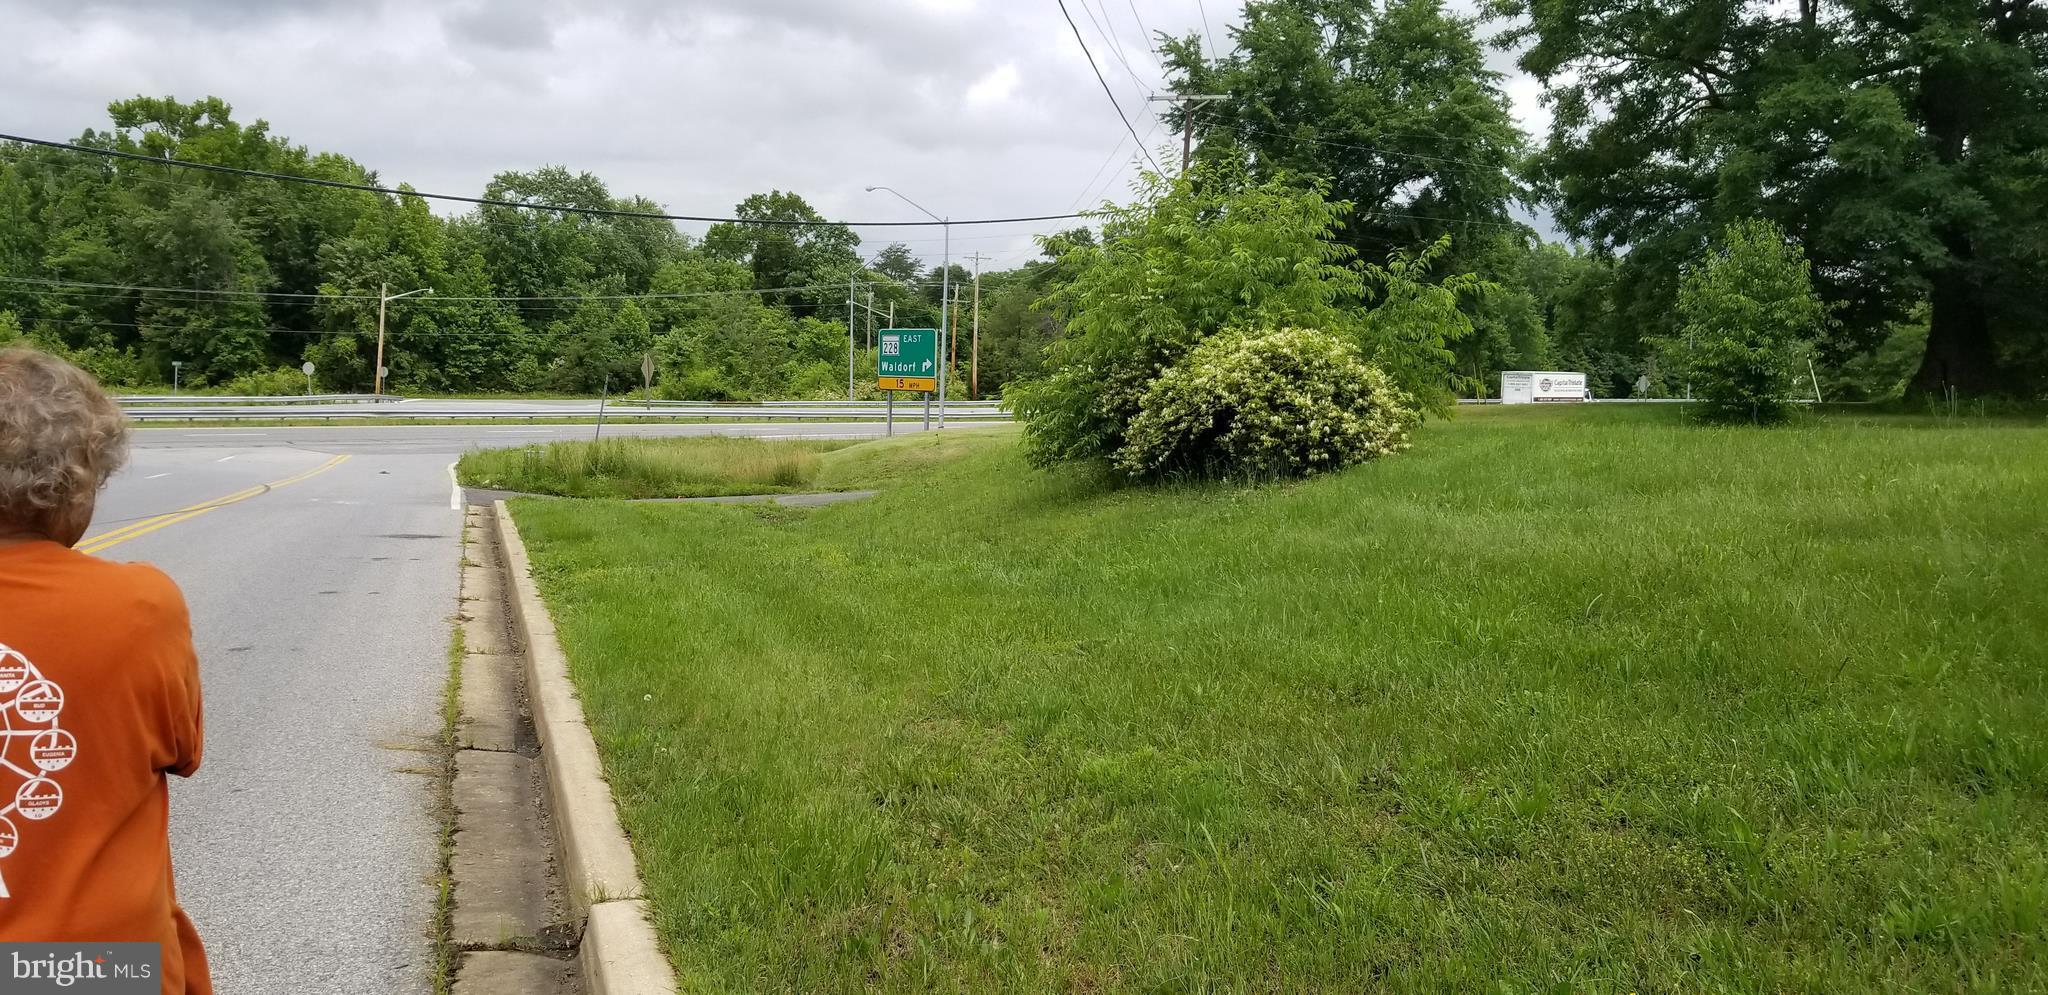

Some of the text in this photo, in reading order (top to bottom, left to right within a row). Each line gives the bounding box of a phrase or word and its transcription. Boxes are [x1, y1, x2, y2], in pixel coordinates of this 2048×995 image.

[883, 342, 898, 354] 228
[881, 361, 916, 372] Waldorf
[896, 379, 905, 388] 15
